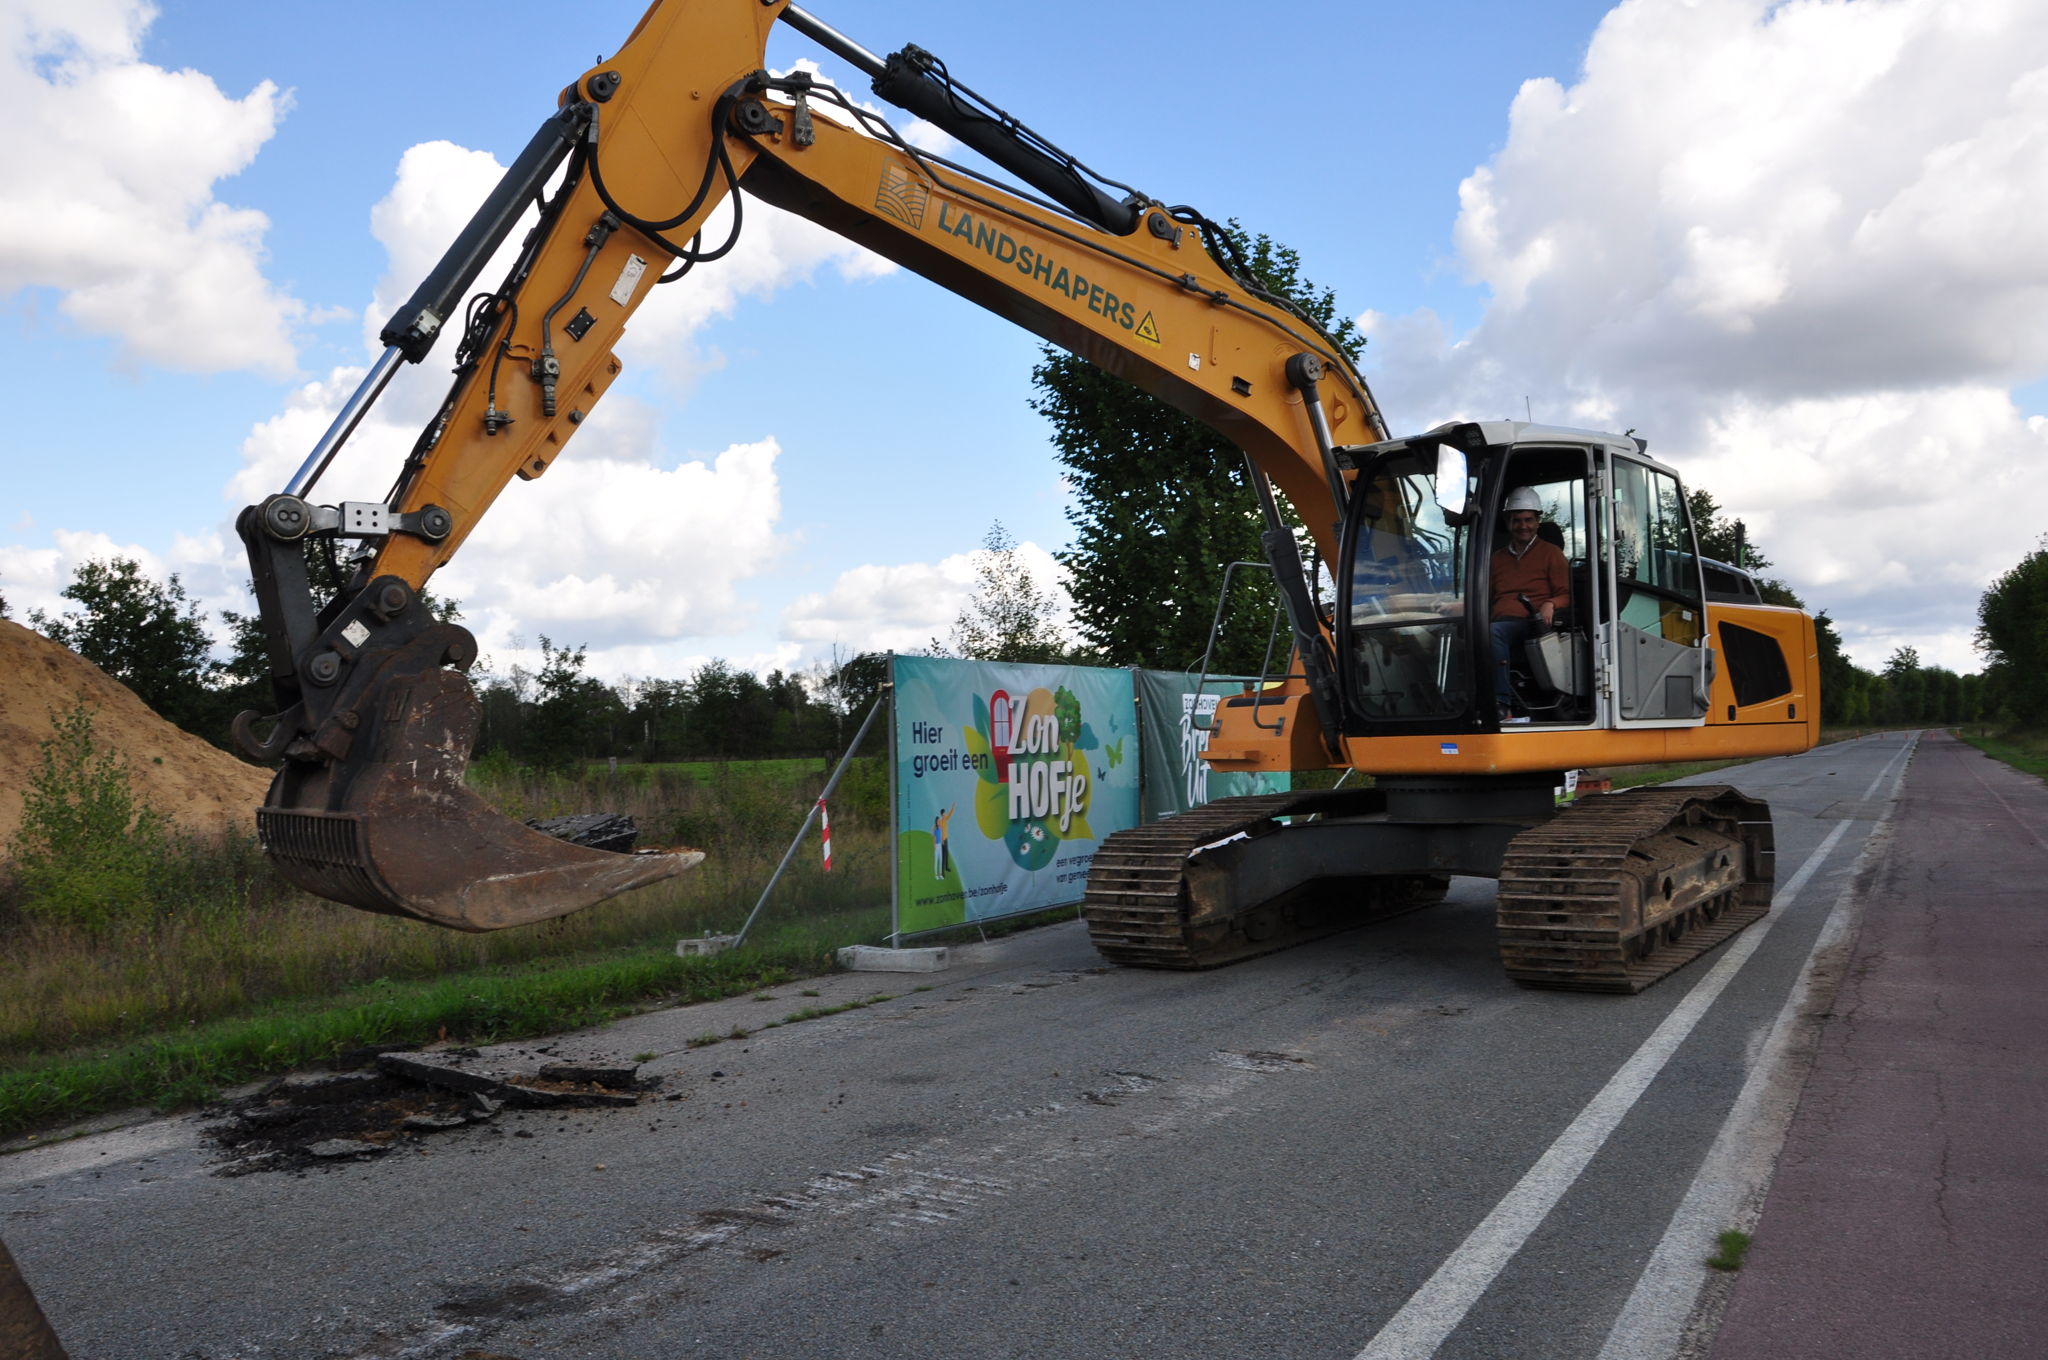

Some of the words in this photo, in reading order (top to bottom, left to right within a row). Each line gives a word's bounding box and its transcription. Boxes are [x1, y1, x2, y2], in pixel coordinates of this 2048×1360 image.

[938, 202, 1136, 330] LANDSHAPERS
[912, 721, 943, 744] Hier
[1007, 695, 1060, 755] Zon
[913, 748, 958, 778] groeit
[962, 753, 988, 770] een
[1008, 760, 1086, 832] HOFje
